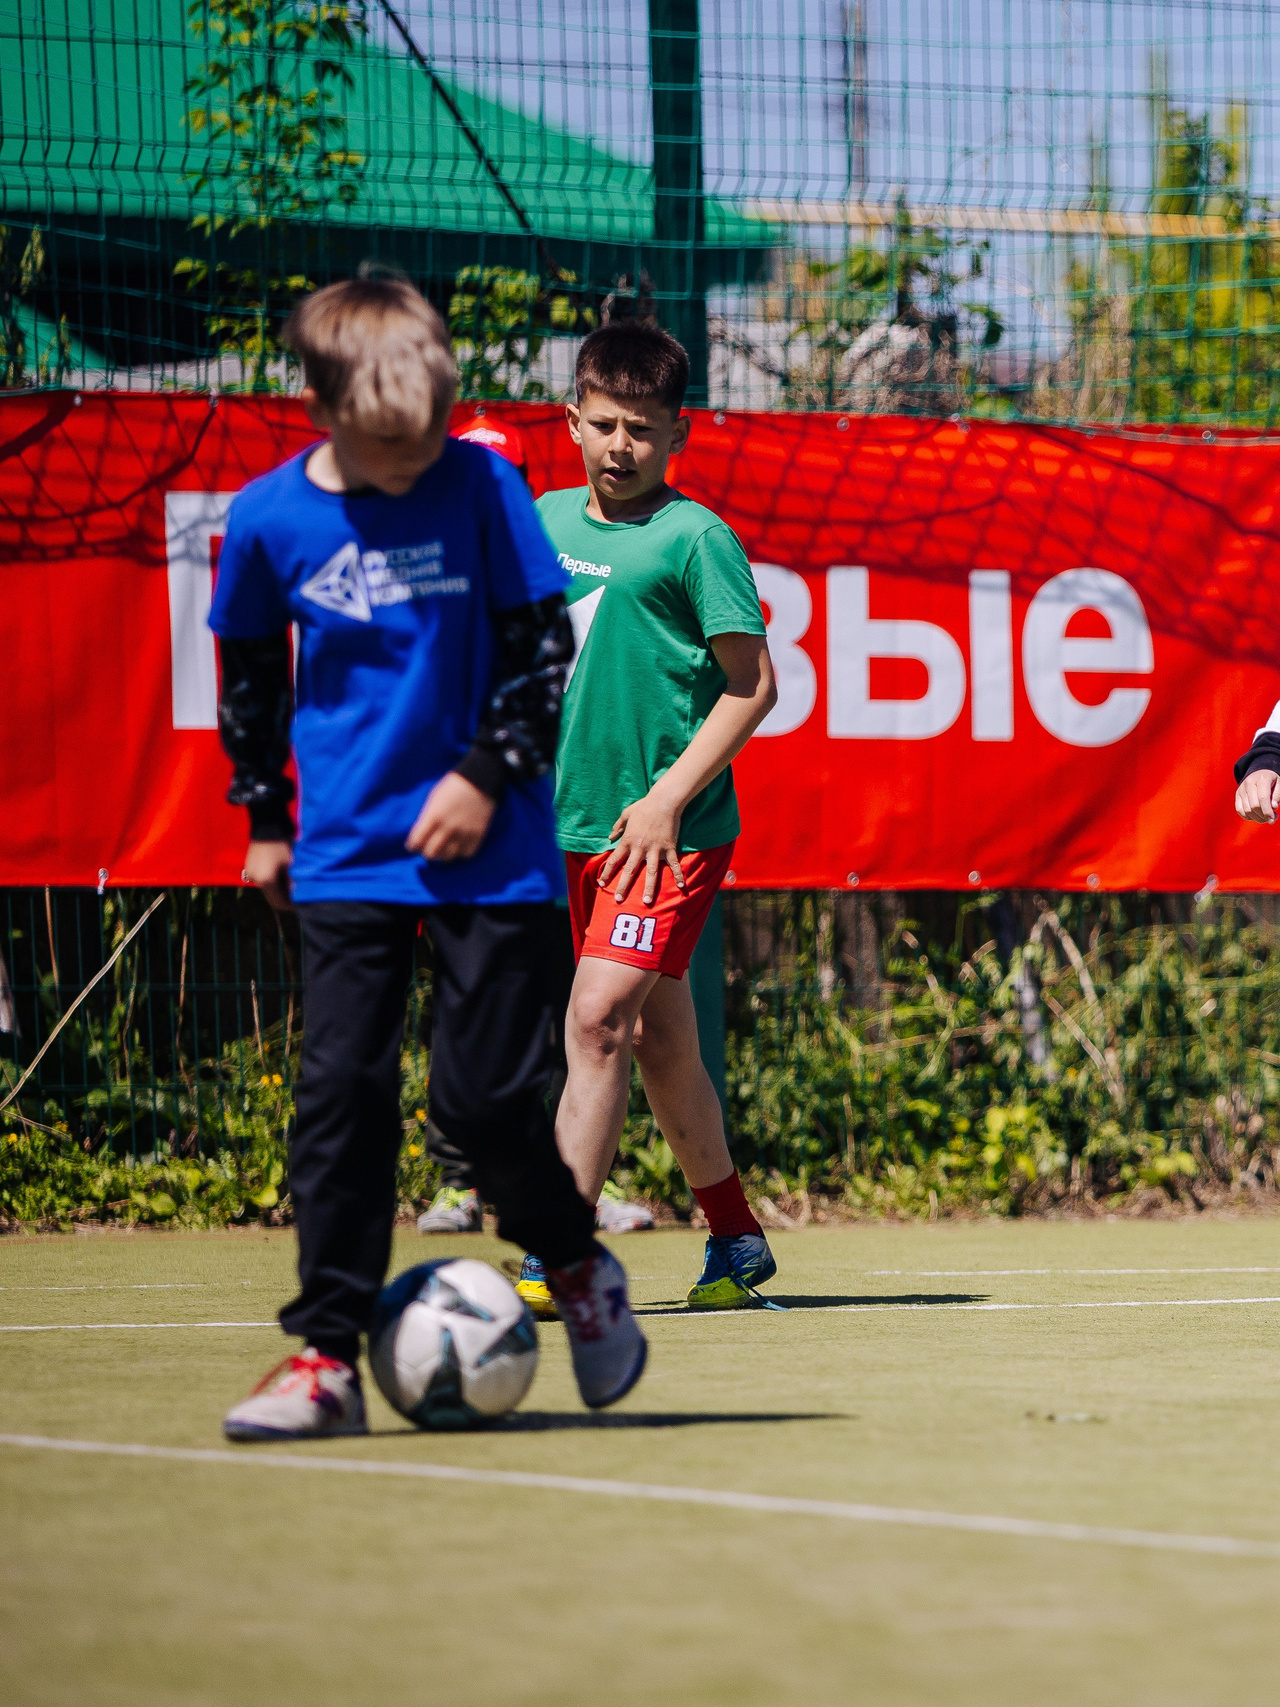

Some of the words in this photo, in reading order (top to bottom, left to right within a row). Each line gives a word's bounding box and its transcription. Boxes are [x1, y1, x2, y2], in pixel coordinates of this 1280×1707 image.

[556, 552, 612, 578] Первые
[165, 490, 1155, 748] Пвые
[609, 913, 657, 953] 81
